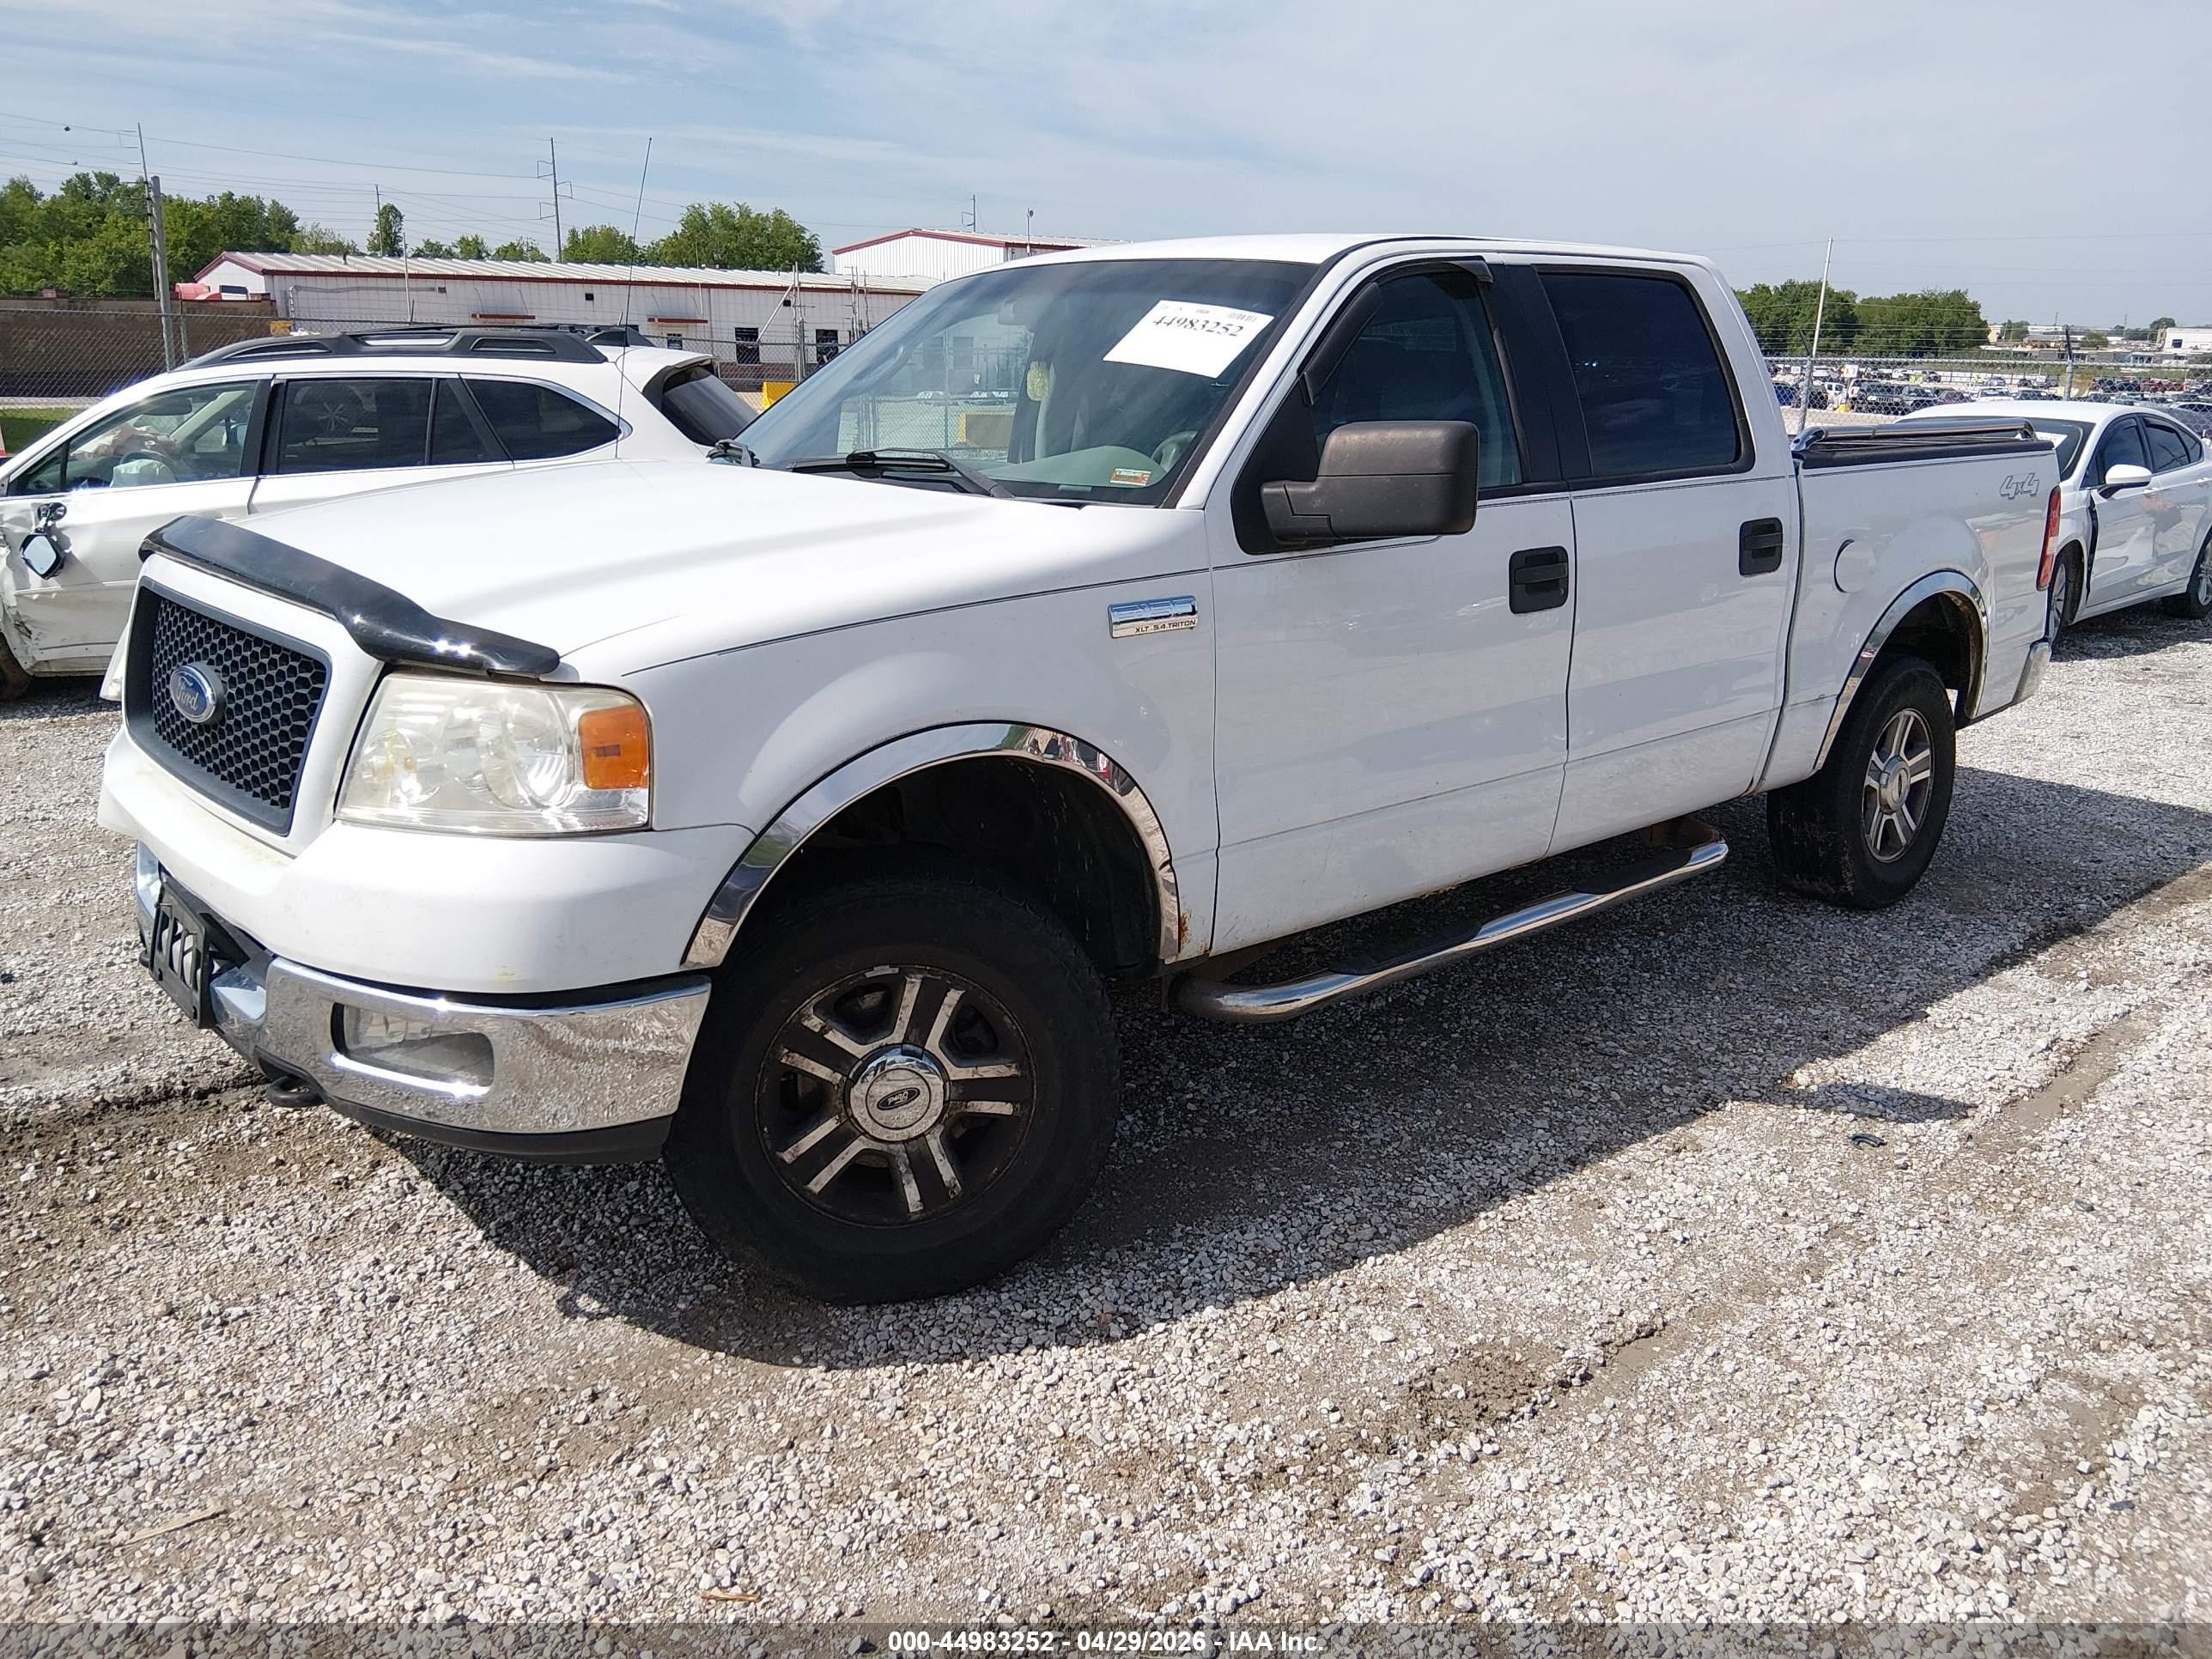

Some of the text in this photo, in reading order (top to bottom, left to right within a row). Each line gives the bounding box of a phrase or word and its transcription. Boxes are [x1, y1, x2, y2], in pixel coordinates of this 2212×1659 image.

[1153, 315, 1243, 337] 44983252
[1999, 472, 2039, 500] 4x4
[1168, 619, 1196, 629] TRITON
[176, 676, 199, 711] Ford
[887, 1091, 908, 1106] Ford
